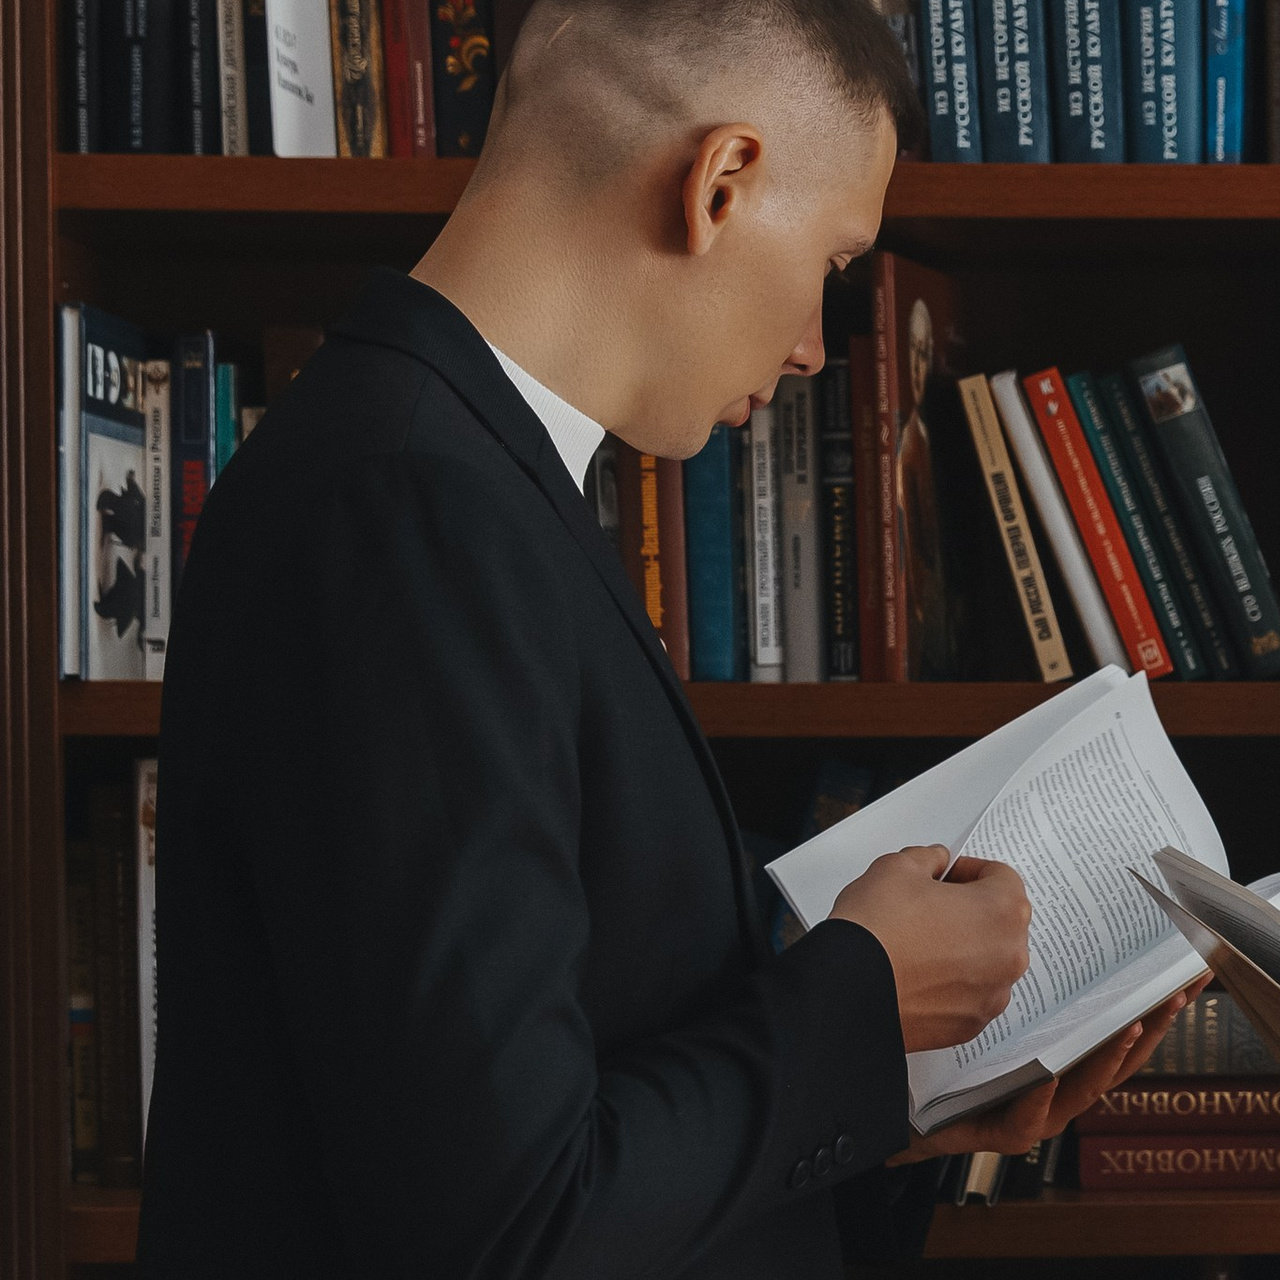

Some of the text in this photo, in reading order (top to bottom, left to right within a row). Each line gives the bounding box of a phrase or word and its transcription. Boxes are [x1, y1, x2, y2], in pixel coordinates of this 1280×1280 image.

[934, 90, 949, 115] ИЗ
[953, 63, 971, 149] РУССКОЙ
[997, 87, 1011, 113] ИЗ
[1015, 60, 1033, 146] РУССКОЙ
[1069, 90, 1083, 117] ИЗ
[1087, 64, 1105, 149] РУССКОЙ
[1140, 6, 1156, 125] ИЗ ИСТОРИИ
[1161, 73, 1178, 159] РУССКОЙ
[879, 451, 891, 525] ЛОМОНОСОВ
